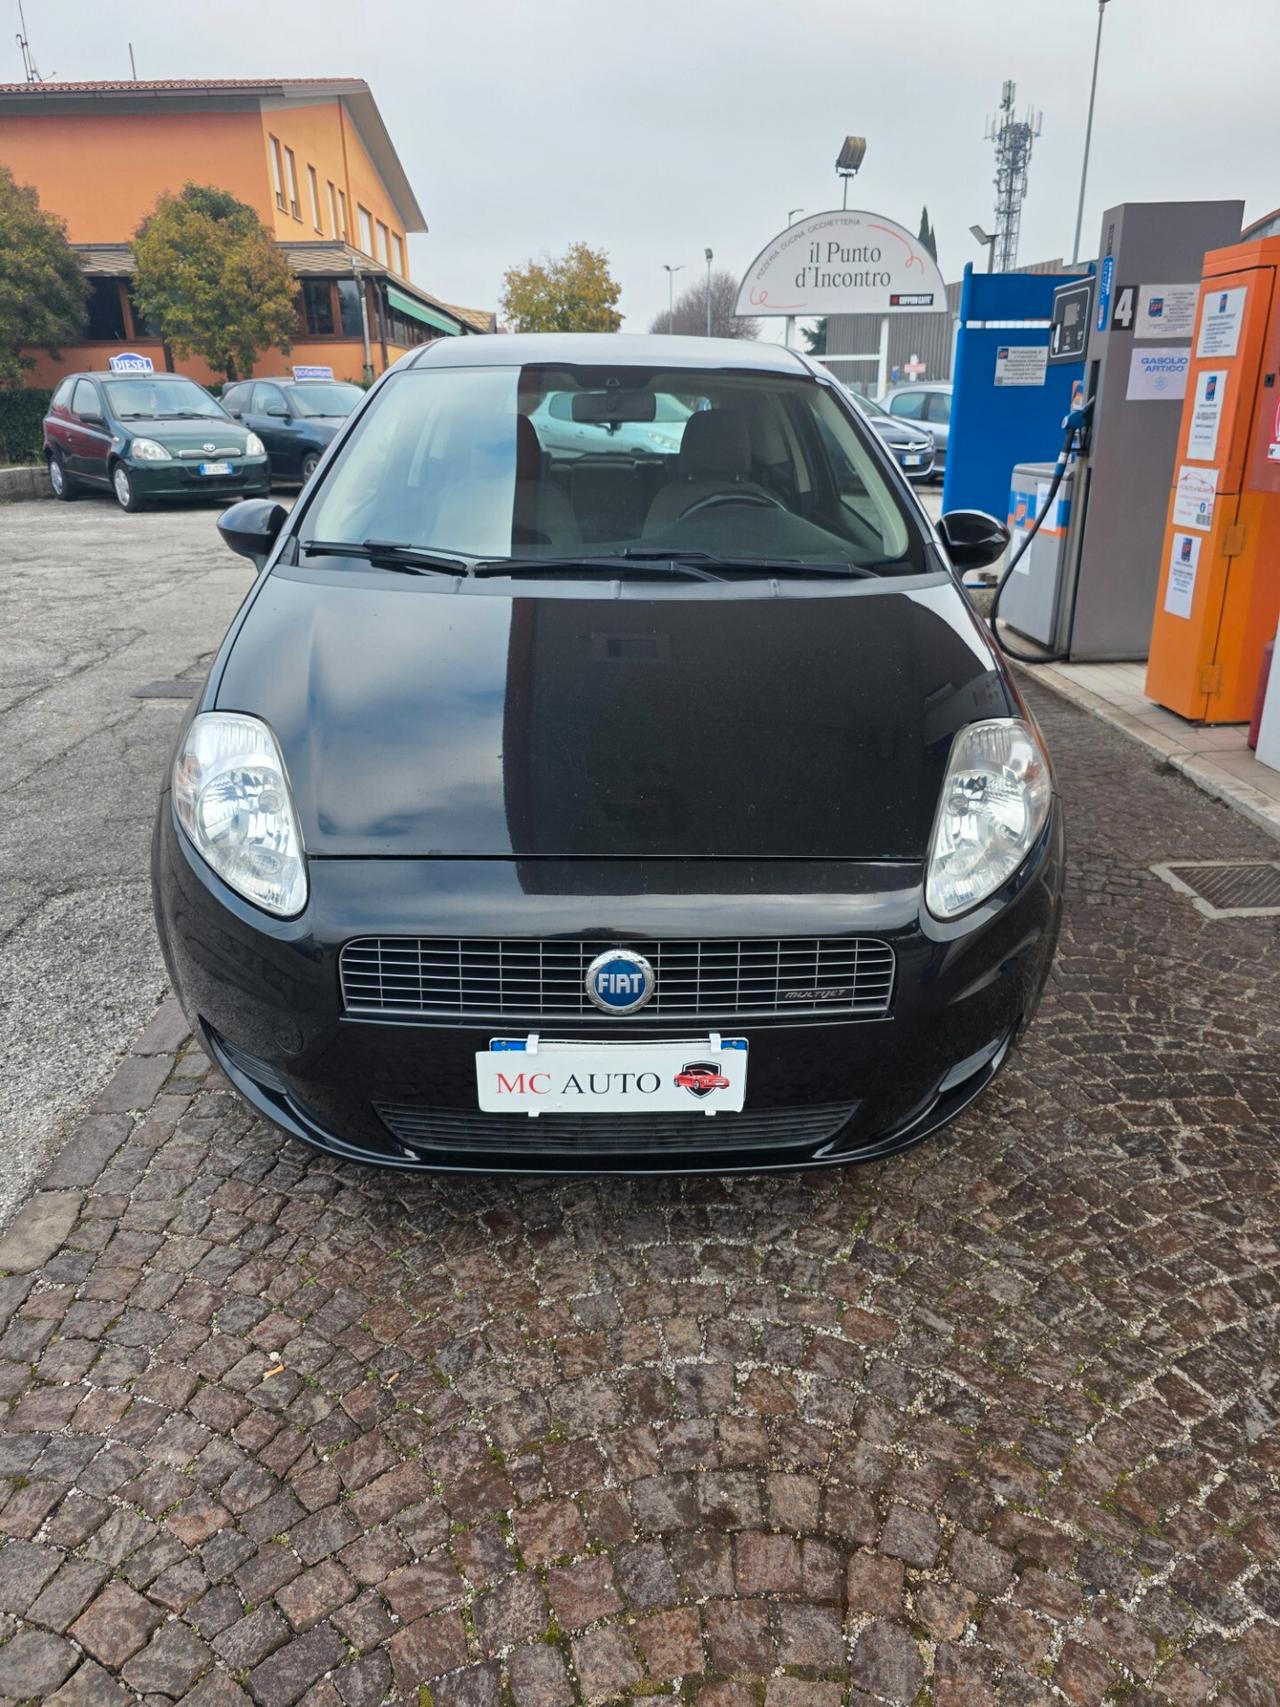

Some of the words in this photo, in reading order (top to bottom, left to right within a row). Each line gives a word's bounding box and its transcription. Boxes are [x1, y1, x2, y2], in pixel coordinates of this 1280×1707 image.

[756, 250, 780, 280] PIZZERIA
[780, 231, 806, 251] CUCINA
[809, 241, 820, 263] il
[827, 241, 881, 263] Punto
[795, 266, 891, 288] d'Incontro
[1113, 289, 1133, 327] 4
[112, 359, 151, 370] DIESEL
[1141, 357, 1188, 365] GASOLIO
[1145, 365, 1184, 373] ARTICO
[598, 973, 643, 994] FIAT
[496, 1072, 552, 1095] MC
[560, 1072, 662, 1095] AUTO
